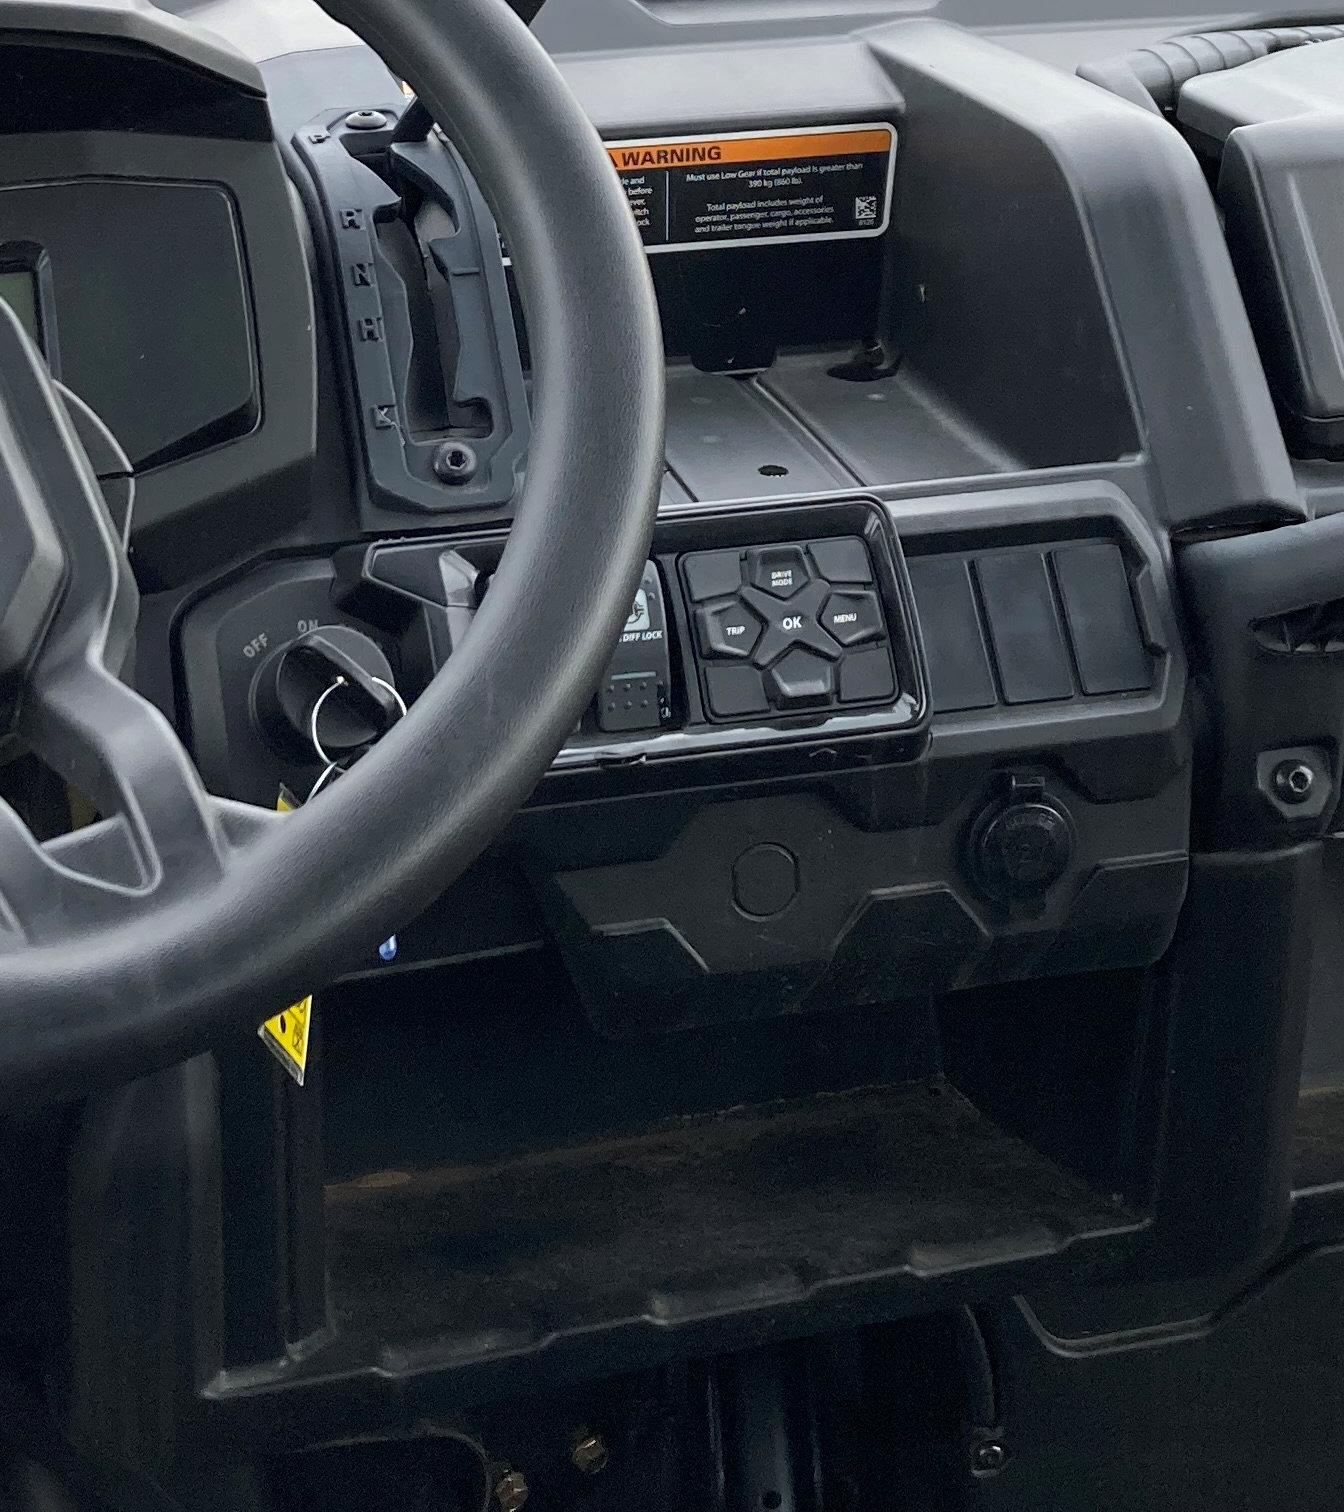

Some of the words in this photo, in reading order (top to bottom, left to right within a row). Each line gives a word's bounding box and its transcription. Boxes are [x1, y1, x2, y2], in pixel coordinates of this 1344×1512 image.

[622, 146, 722, 167] WARNING
[686, 174, 705, 182] Must
[721, 171, 737, 179] Low
[738, 170, 755, 178] Gear
[763, 168, 780, 176] total
[782, 166, 811, 176] payload
[819, 164, 845, 174] greater
[846, 162, 863, 170] than
[707, 202, 726, 211] Total
[726, 200, 756, 211] payload
[757, 198, 787, 208] includes
[815, 195, 823, 204] of
[340, 209, 365, 230] R
[695, 225, 710, 233] and
[711, 223, 733, 231] trailer
[353, 263, 375, 287] N
[359, 317, 384, 341] H
[771, 570, 792, 579] DRIVE
[771, 577, 793, 587] MODE
[783, 617, 802, 630] OK
[834, 613, 857, 624] MENU
[297, 619, 319, 633] ON
[727, 625, 746, 636] TRIP
[623, 632, 641, 642] DIFF
[642, 630, 663, 641] LOCK
[243, 633, 268, 658] OFF
